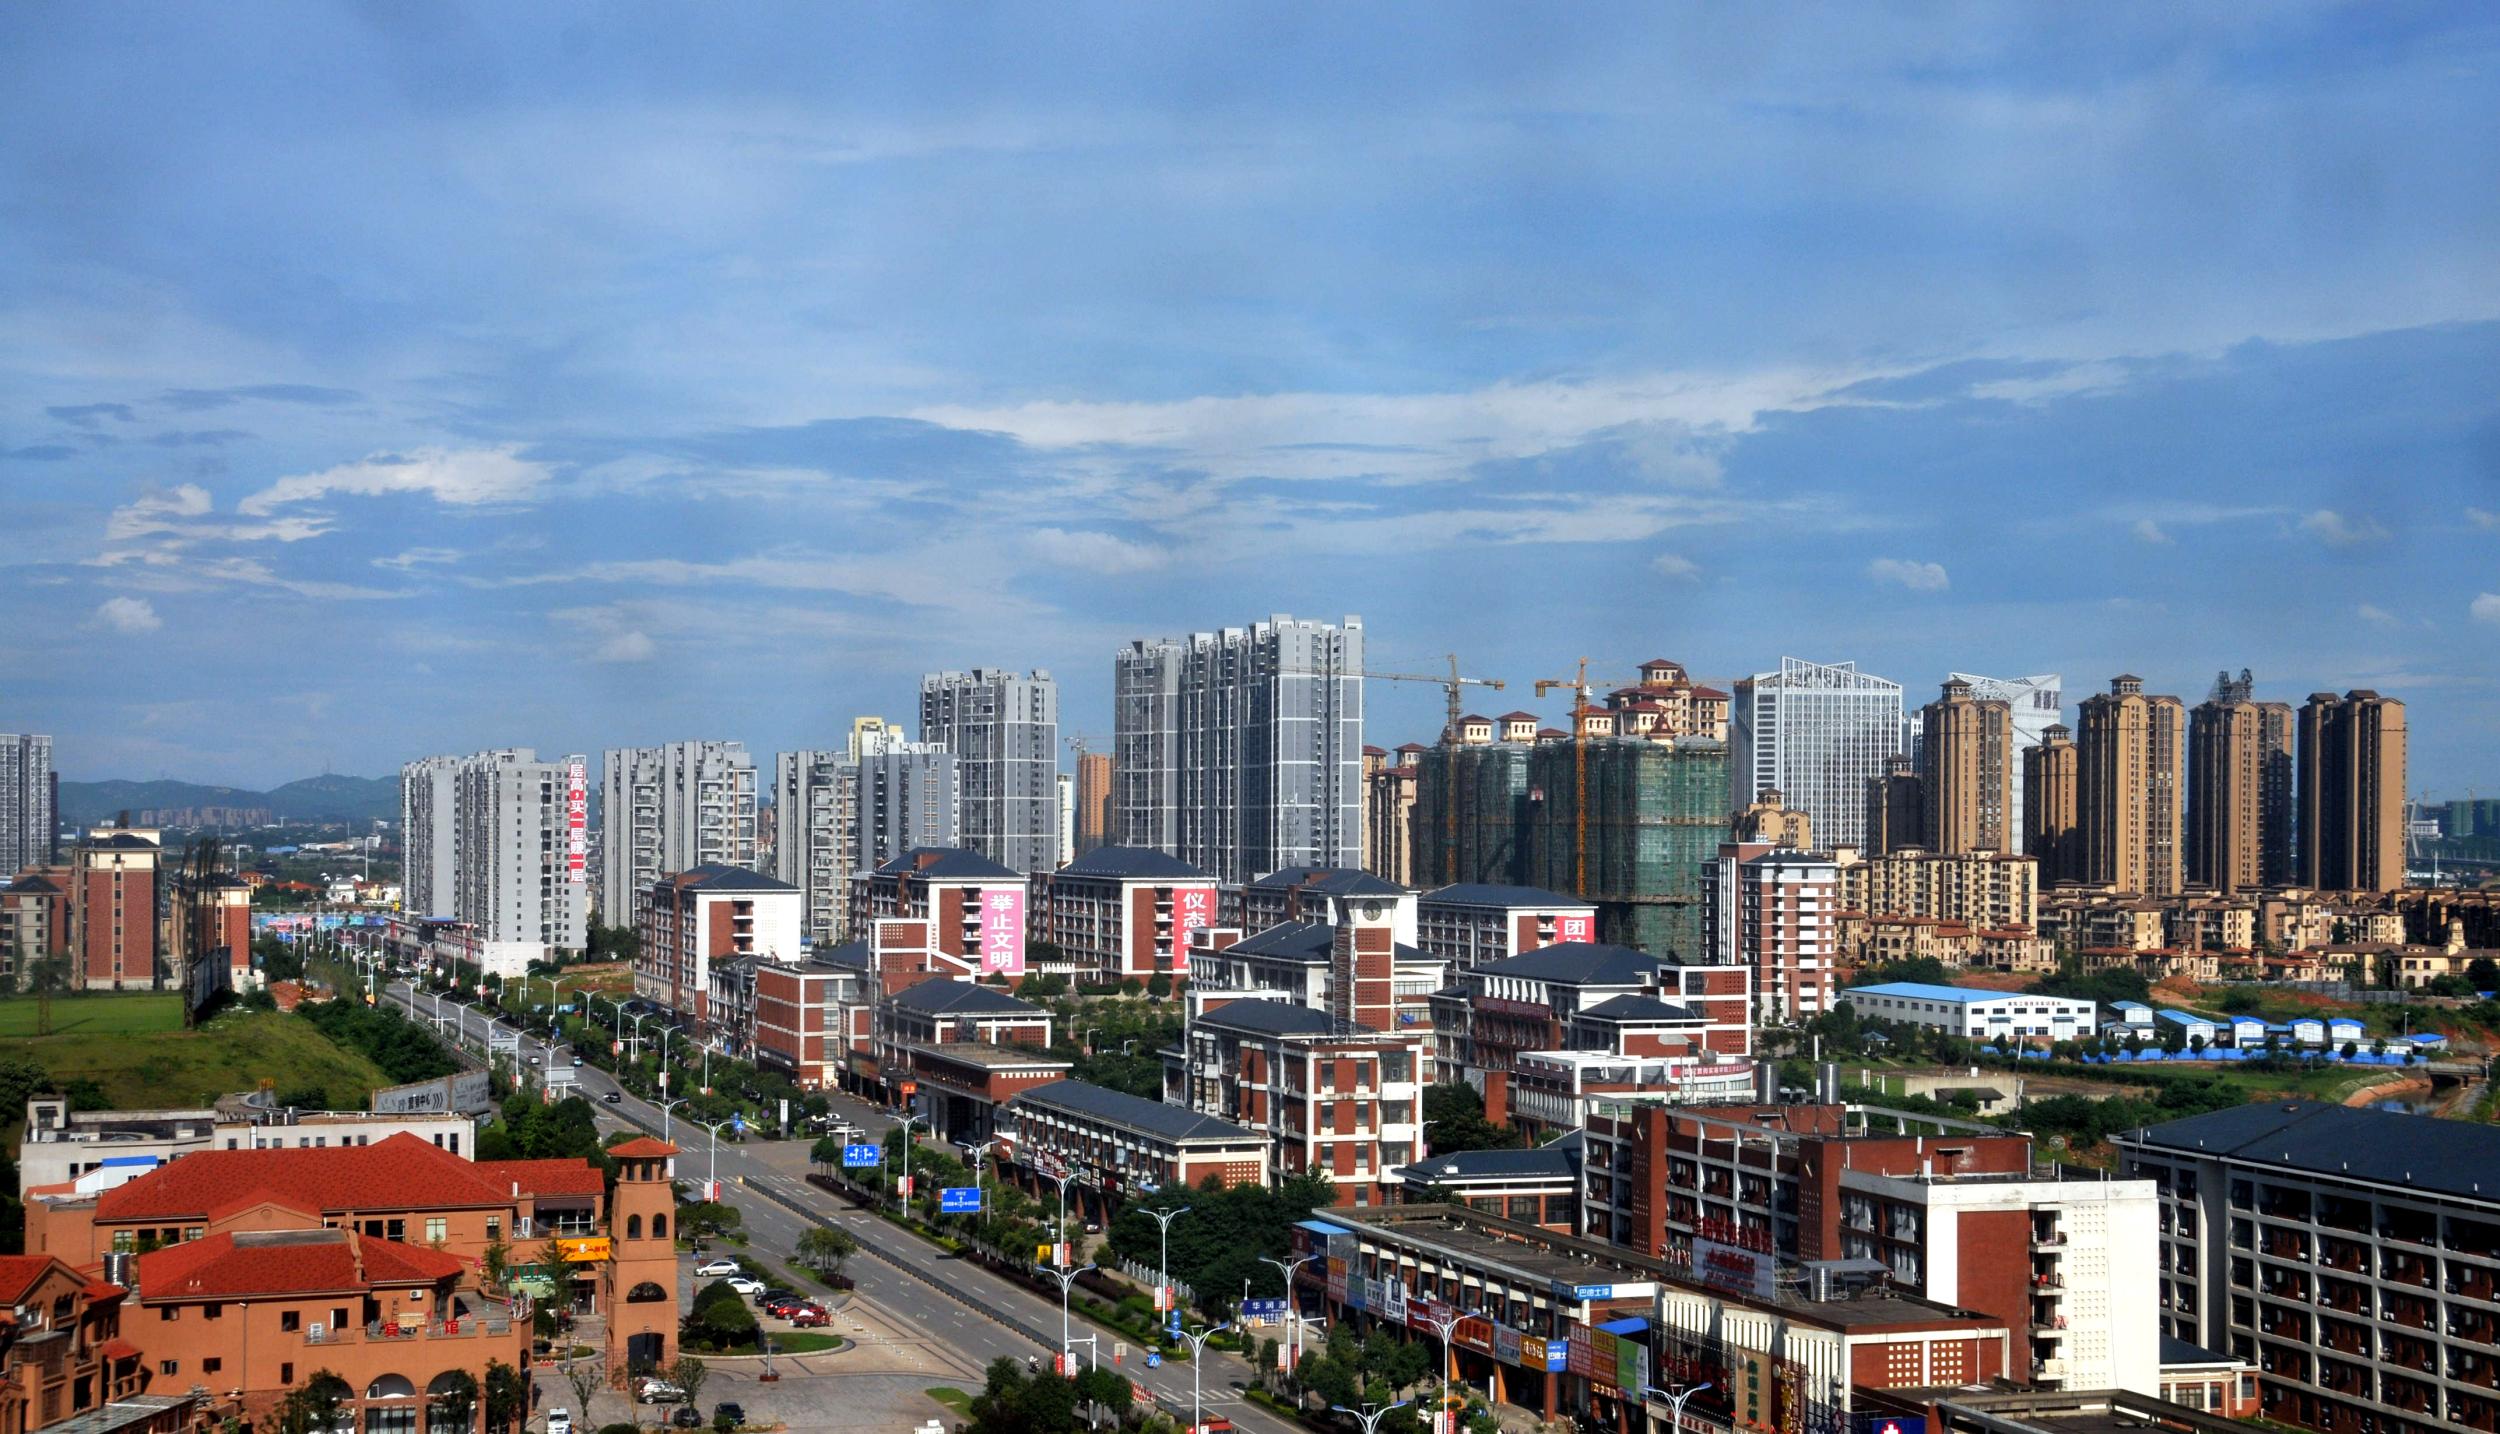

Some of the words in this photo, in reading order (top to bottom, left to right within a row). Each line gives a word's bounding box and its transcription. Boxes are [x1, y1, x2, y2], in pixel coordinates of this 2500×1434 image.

[989, 894, 1014, 968] 举止文明
[1182, 892, 1208, 965] 仪态
[1565, 919, 1587, 943] 团
[385, 1320, 459, 1338] 宾馆
